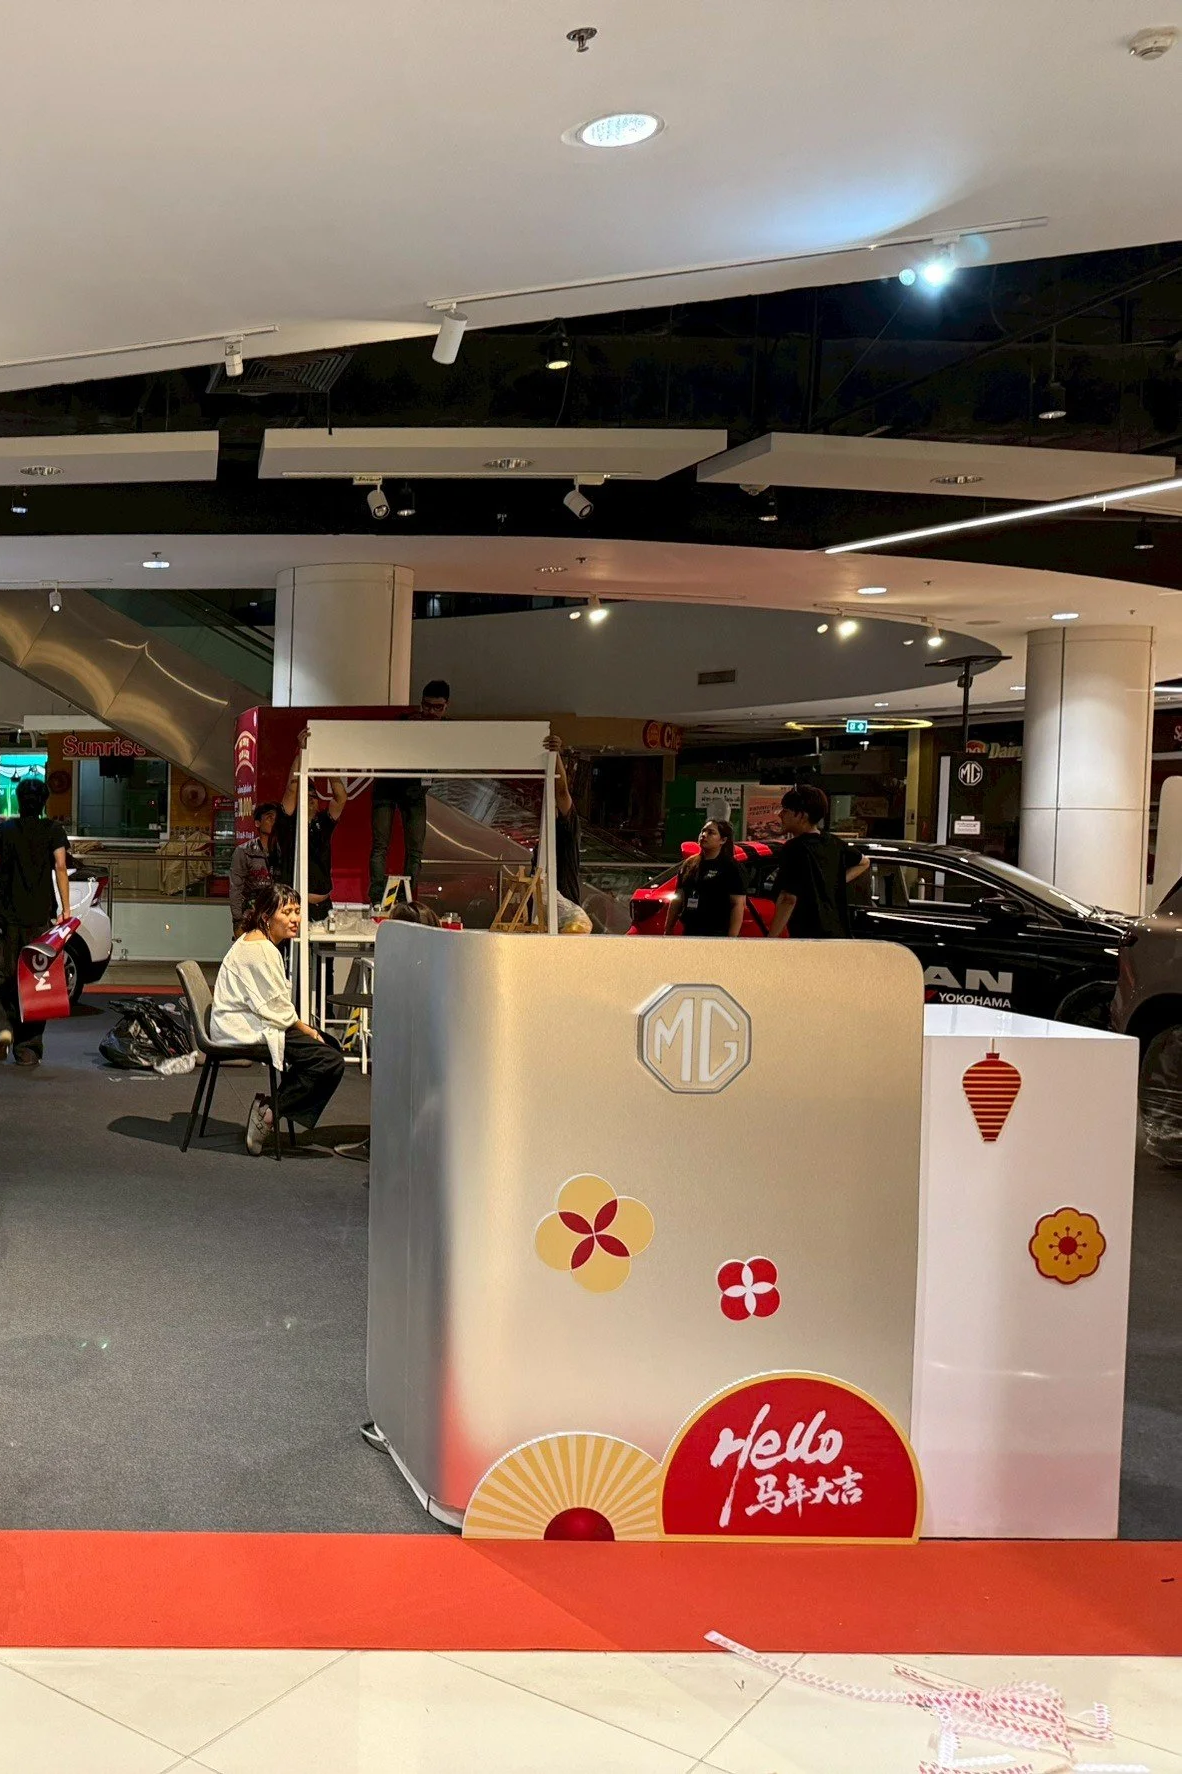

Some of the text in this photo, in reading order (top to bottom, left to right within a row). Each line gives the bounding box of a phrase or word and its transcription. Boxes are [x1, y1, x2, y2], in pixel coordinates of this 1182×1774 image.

[712, 786, 733, 795] ATM
[959, 762, 982, 785] MG
[938, 991, 1012, 1009] YOKOHAMA
[650, 994, 743, 1085] MG
[709, 1403, 844, 1528] Hello
[744, 1464, 864, 1518] 马年大吉
